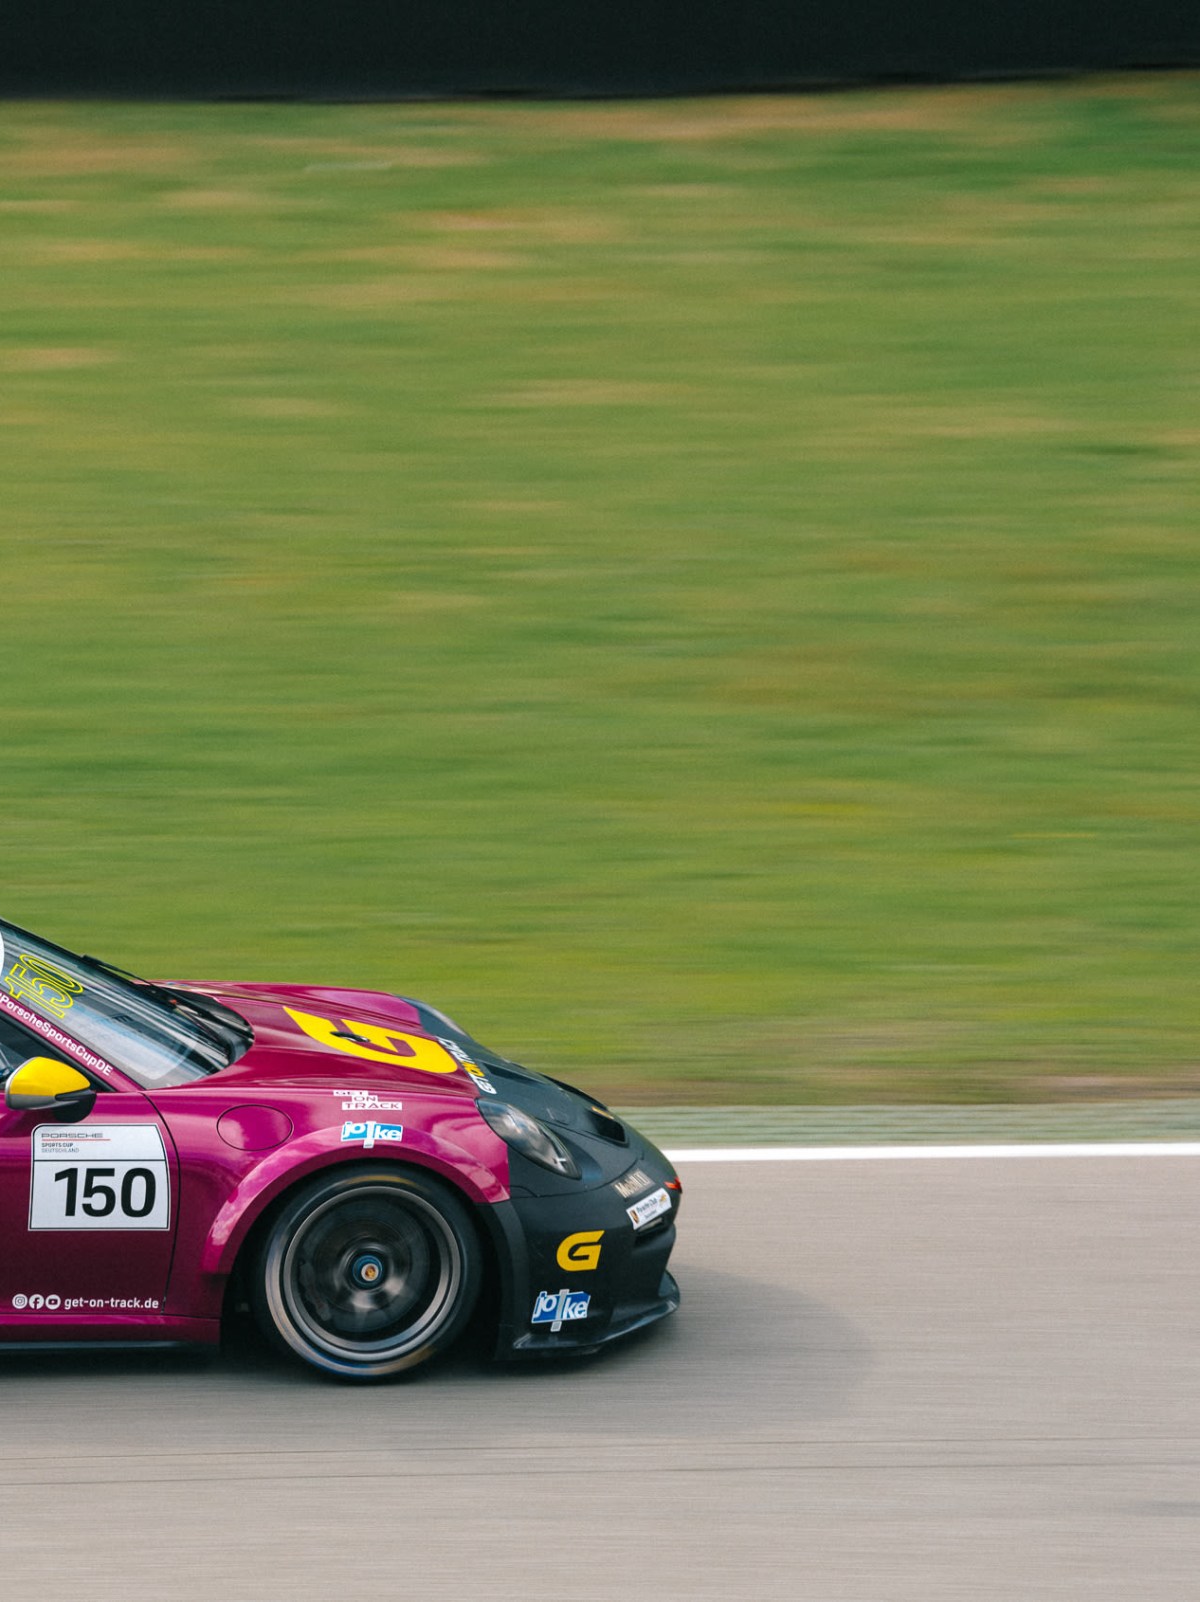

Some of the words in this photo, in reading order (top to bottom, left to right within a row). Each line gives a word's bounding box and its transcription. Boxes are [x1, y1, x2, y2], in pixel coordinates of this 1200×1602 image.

[3, 954, 84, 1019] 150
[54, 1167, 156, 1218] 150
[64, 1297, 160, 1310] get-on-track.de
